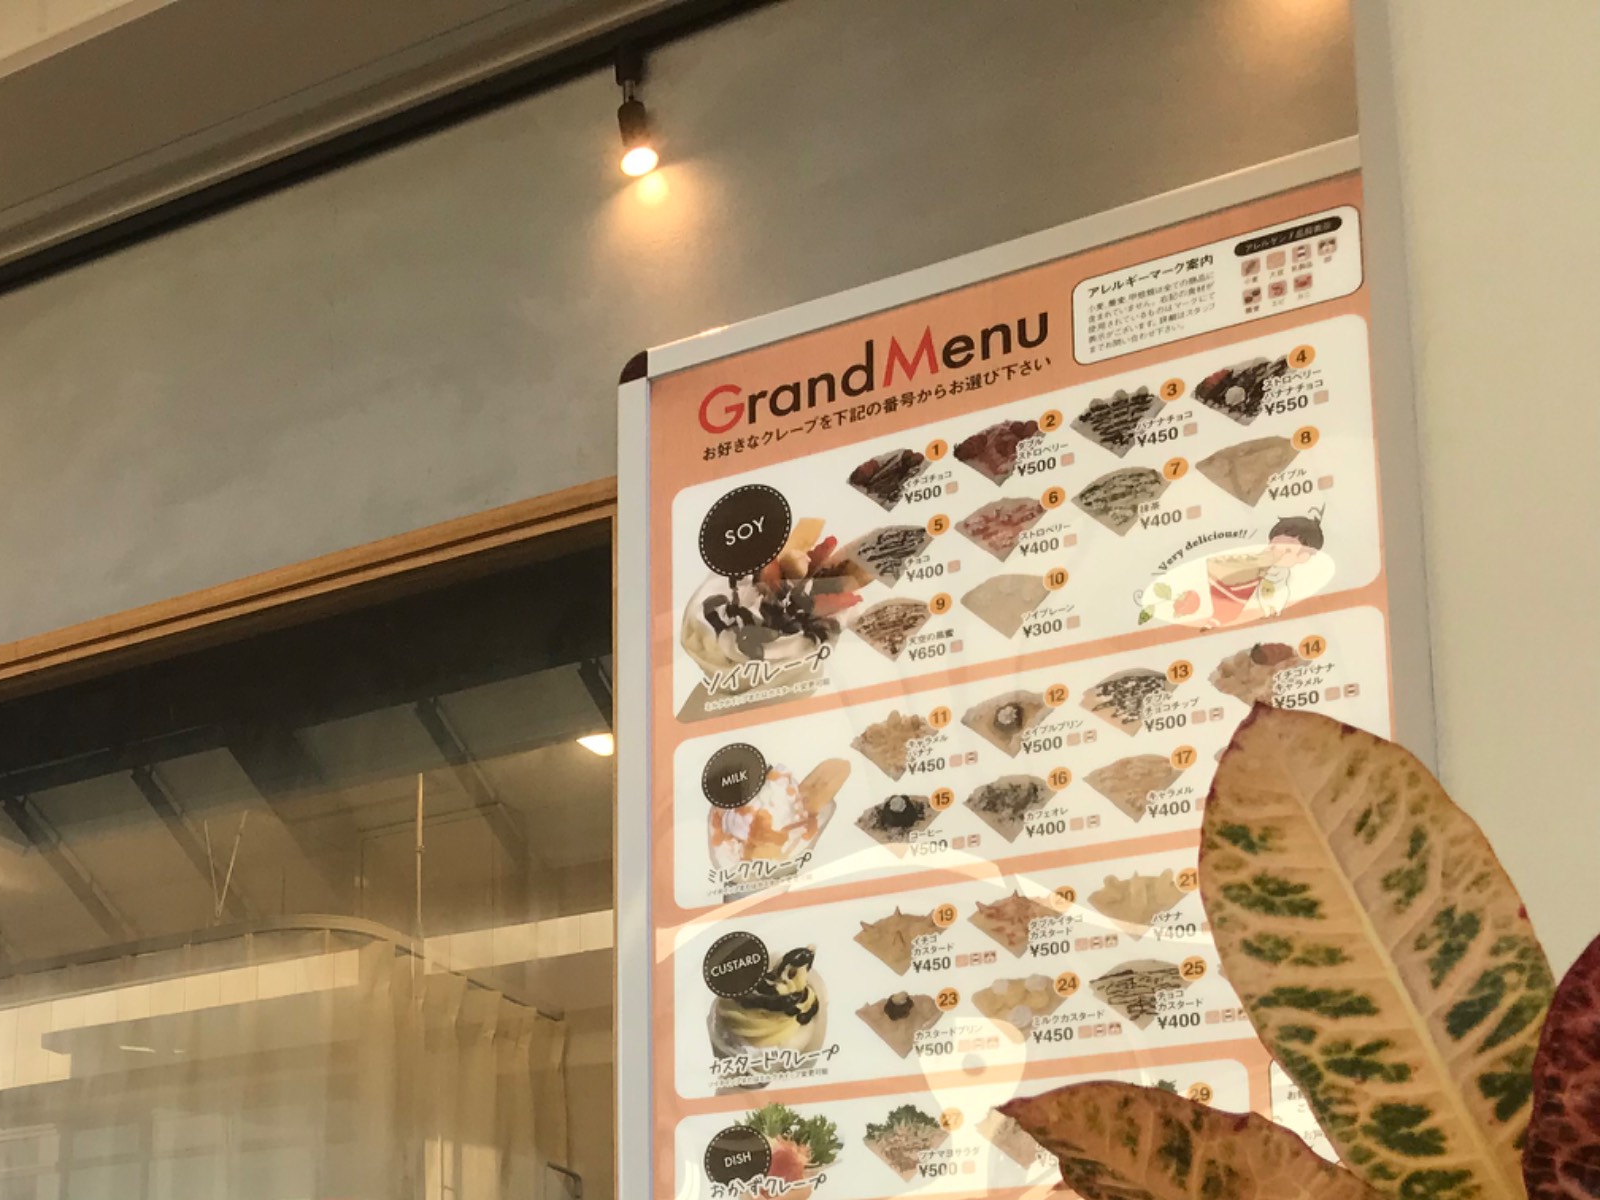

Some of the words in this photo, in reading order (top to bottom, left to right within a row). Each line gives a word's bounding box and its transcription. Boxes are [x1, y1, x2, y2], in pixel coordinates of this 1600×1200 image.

[1087, 254, 1214, 298] アレルギーマーク案内
[1294, 350, 1307, 363] 4
[1263, 369, 1322, 388] ストロベリー
[1166, 383, 1178, 397] 3
[1264, 379, 1325, 399] バナナチョコ
[1264, 395, 1309, 416] ¥550
[1045, 414, 1057, 428] 2
[1136, 410, 1194, 430] バナナチョコ
[1016, 437, 1044, 452] ダブル
[1136, 427, 1179, 448] ¥450
[1299, 431, 1312, 445] 8
[933, 444, 941, 456] 1
[1017, 443, 1069, 460] ストロベリー
[1017, 457, 1057, 477] ¥500
[1170, 463, 1182, 477] 7
[904, 471, 953, 489] イチゴチョコ
[904, 485, 943, 504] ¥500
[1048, 491, 1059, 505] 6
[1268, 480, 1314, 501] ¥400
[1139, 502, 1161, 514] 抹茶
[933, 518, 945, 533] 5
[1140, 510, 1183, 530] ¥400
[725, 516, 767, 547] SOY
[1019, 523, 1072, 541] ストロベリー
[1019, 537, 1060, 557] ¥400
[906, 555, 932, 568] チョコ
[1157, 549, 1185, 574] Very
[906, 563, 945, 583] ¥400
[1046, 571, 1066, 587] 10
[935, 597, 947, 611] 9
[1022, 619, 1064, 638] ¥300
[908, 643, 947, 662] ¥650
[1302, 640, 1322, 655] 14
[701, 645, 832, 695] ソイクレープ
[1171, 663, 1189, 680] 13
[1274, 676, 1325, 696] キャラメル
[1047, 688, 1065, 702] 12
[1274, 690, 1321, 710] ¥550
[1145, 696, 1201, 717] チョコチップ
[933, 711, 948, 725] 11
[1144, 713, 1188, 734] ¥500
[1022, 736, 1064, 756] ¥500
[907, 757, 946, 776] ¥450
[1174, 750, 1193, 766] 17
[721, 769, 749, 789] MILK
[1050, 771, 1068, 786] 16
[934, 791, 951, 805] 15
[1148, 785, 1195, 801] キャラメル
[1025, 807, 1069, 822] カフェオレ
[1148, 800, 1192, 820] ¥400
[910, 828, 944, 841] コーヒー
[1025, 820, 1067, 839] ¥400
[910, 838, 949, 857] ¥500
[706, 851, 813, 884] ミルククレープ
[1179, 873, 1198, 888] 21
[1055, 889, 1076, 906] 20
[937, 908, 955, 923] 19
[1153, 911, 1184, 923] バナナ
[1030, 927, 1073, 941] カスタード
[913, 943, 955, 957] カスタード
[1029, 940, 1071, 958] ¥500
[710, 953, 762, 978] CUSTARD
[912, 957, 952, 974] ¥450
[1182, 962, 1205, 977] 25
[1056, 976, 1077, 993] 24
[938, 991, 958, 1008] 23
[1156, 990, 1185, 1002] チョコ
[1156, 998, 1204, 1012] カスタード
[1032, 1009, 1105, 1027] ミルクカスタード
[1156, 1012, 1201, 1031] ¥400
[1032, 1027, 1074, 1045] ¥450
[915, 1041, 954, 1058] ¥500
[709, 1044, 841, 1076] カスタードクレープ
[1189, 1086, 1212, 1102] 29
[724, 1151, 753, 1169] DISH
[918, 1162, 958, 1179] ¥500
[710, 1172, 829, 1199] おかずクレープ
